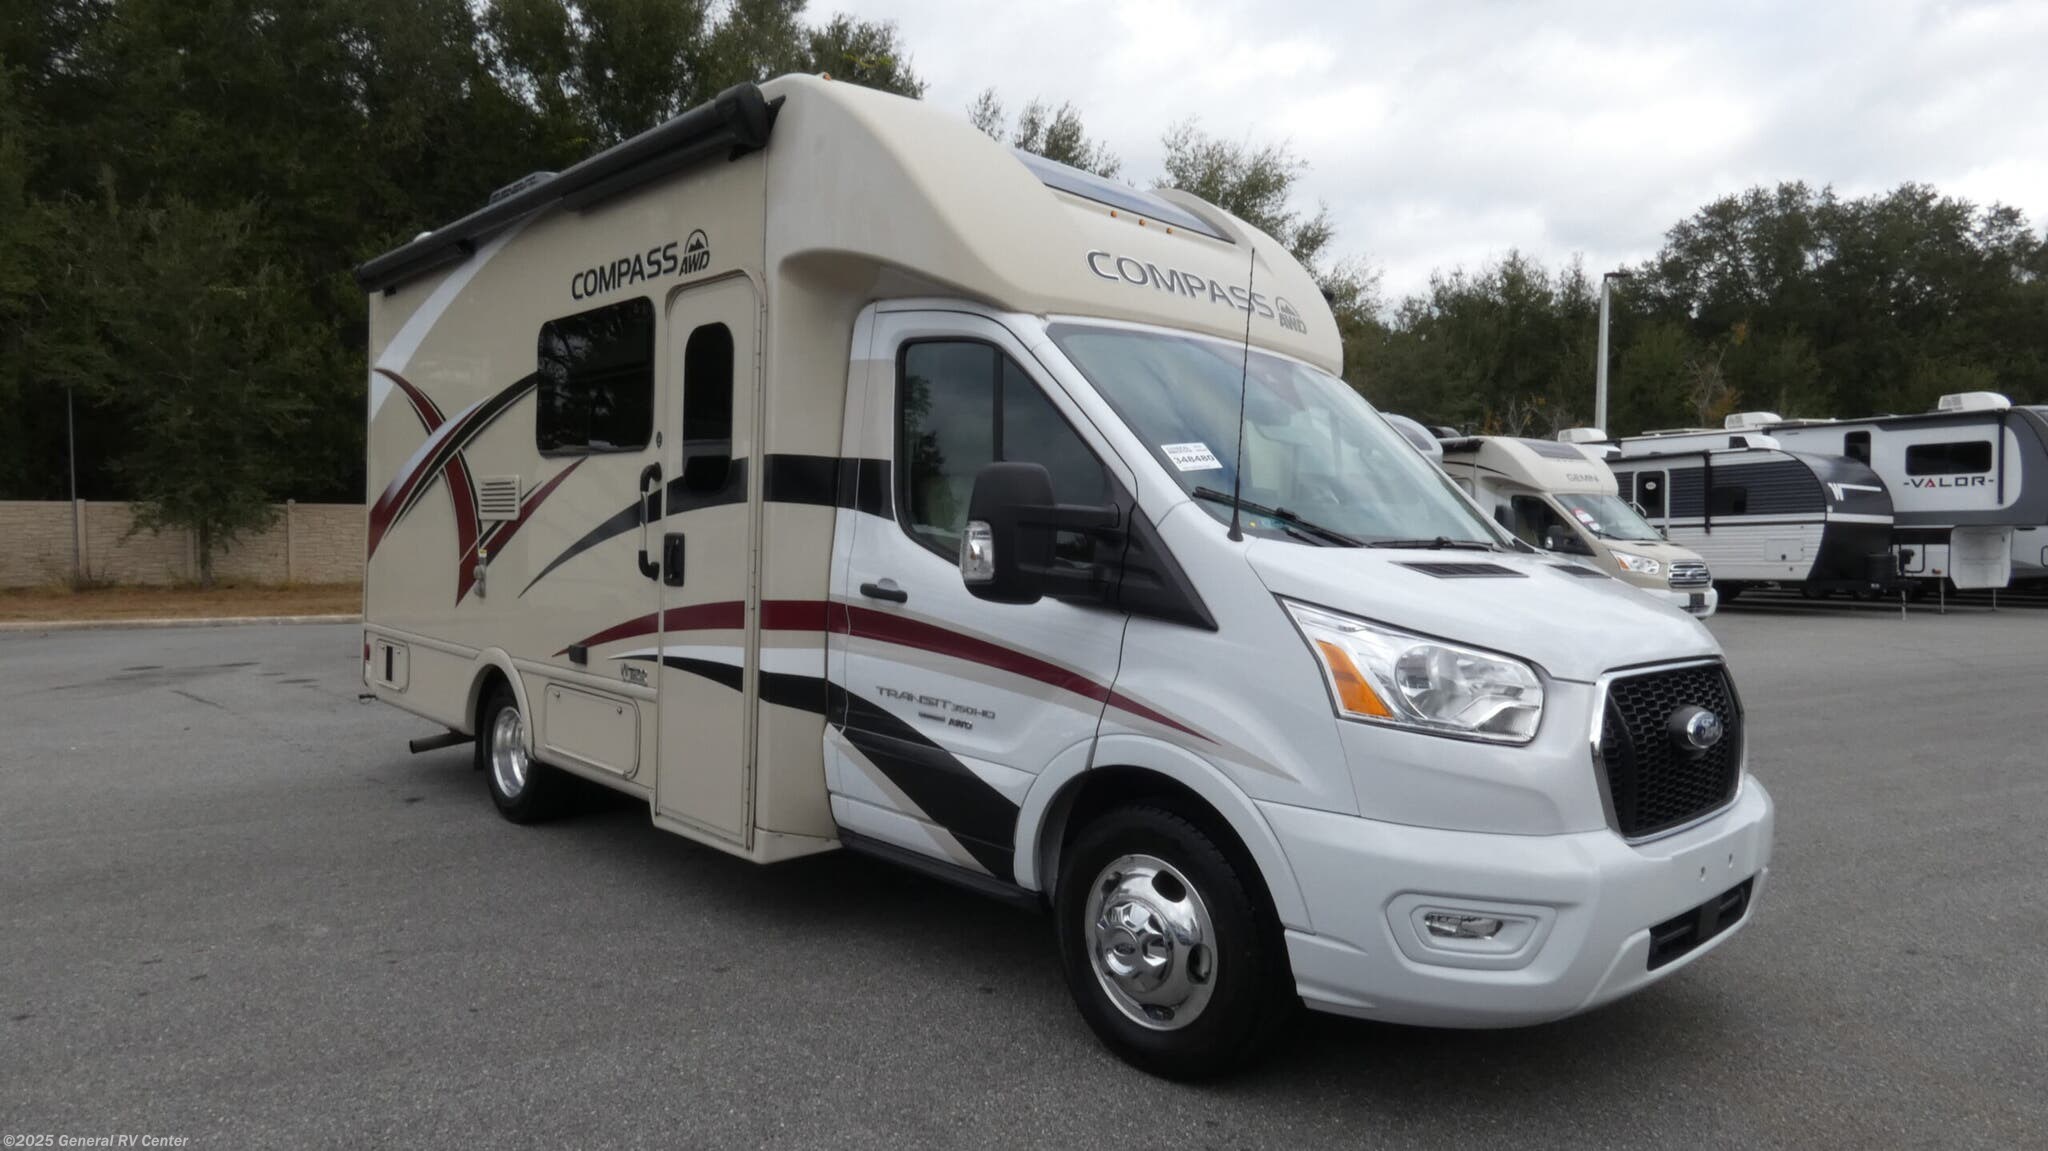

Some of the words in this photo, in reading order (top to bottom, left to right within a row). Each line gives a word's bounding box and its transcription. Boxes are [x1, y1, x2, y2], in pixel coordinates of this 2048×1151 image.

[572, 242, 678, 300] COMPASS
[679, 250, 710, 276] AWD
[1087, 251, 1275, 319] COMPASS
[1279, 314, 1307, 334] AWD
[876, 685, 952, 709] TRANSIT
